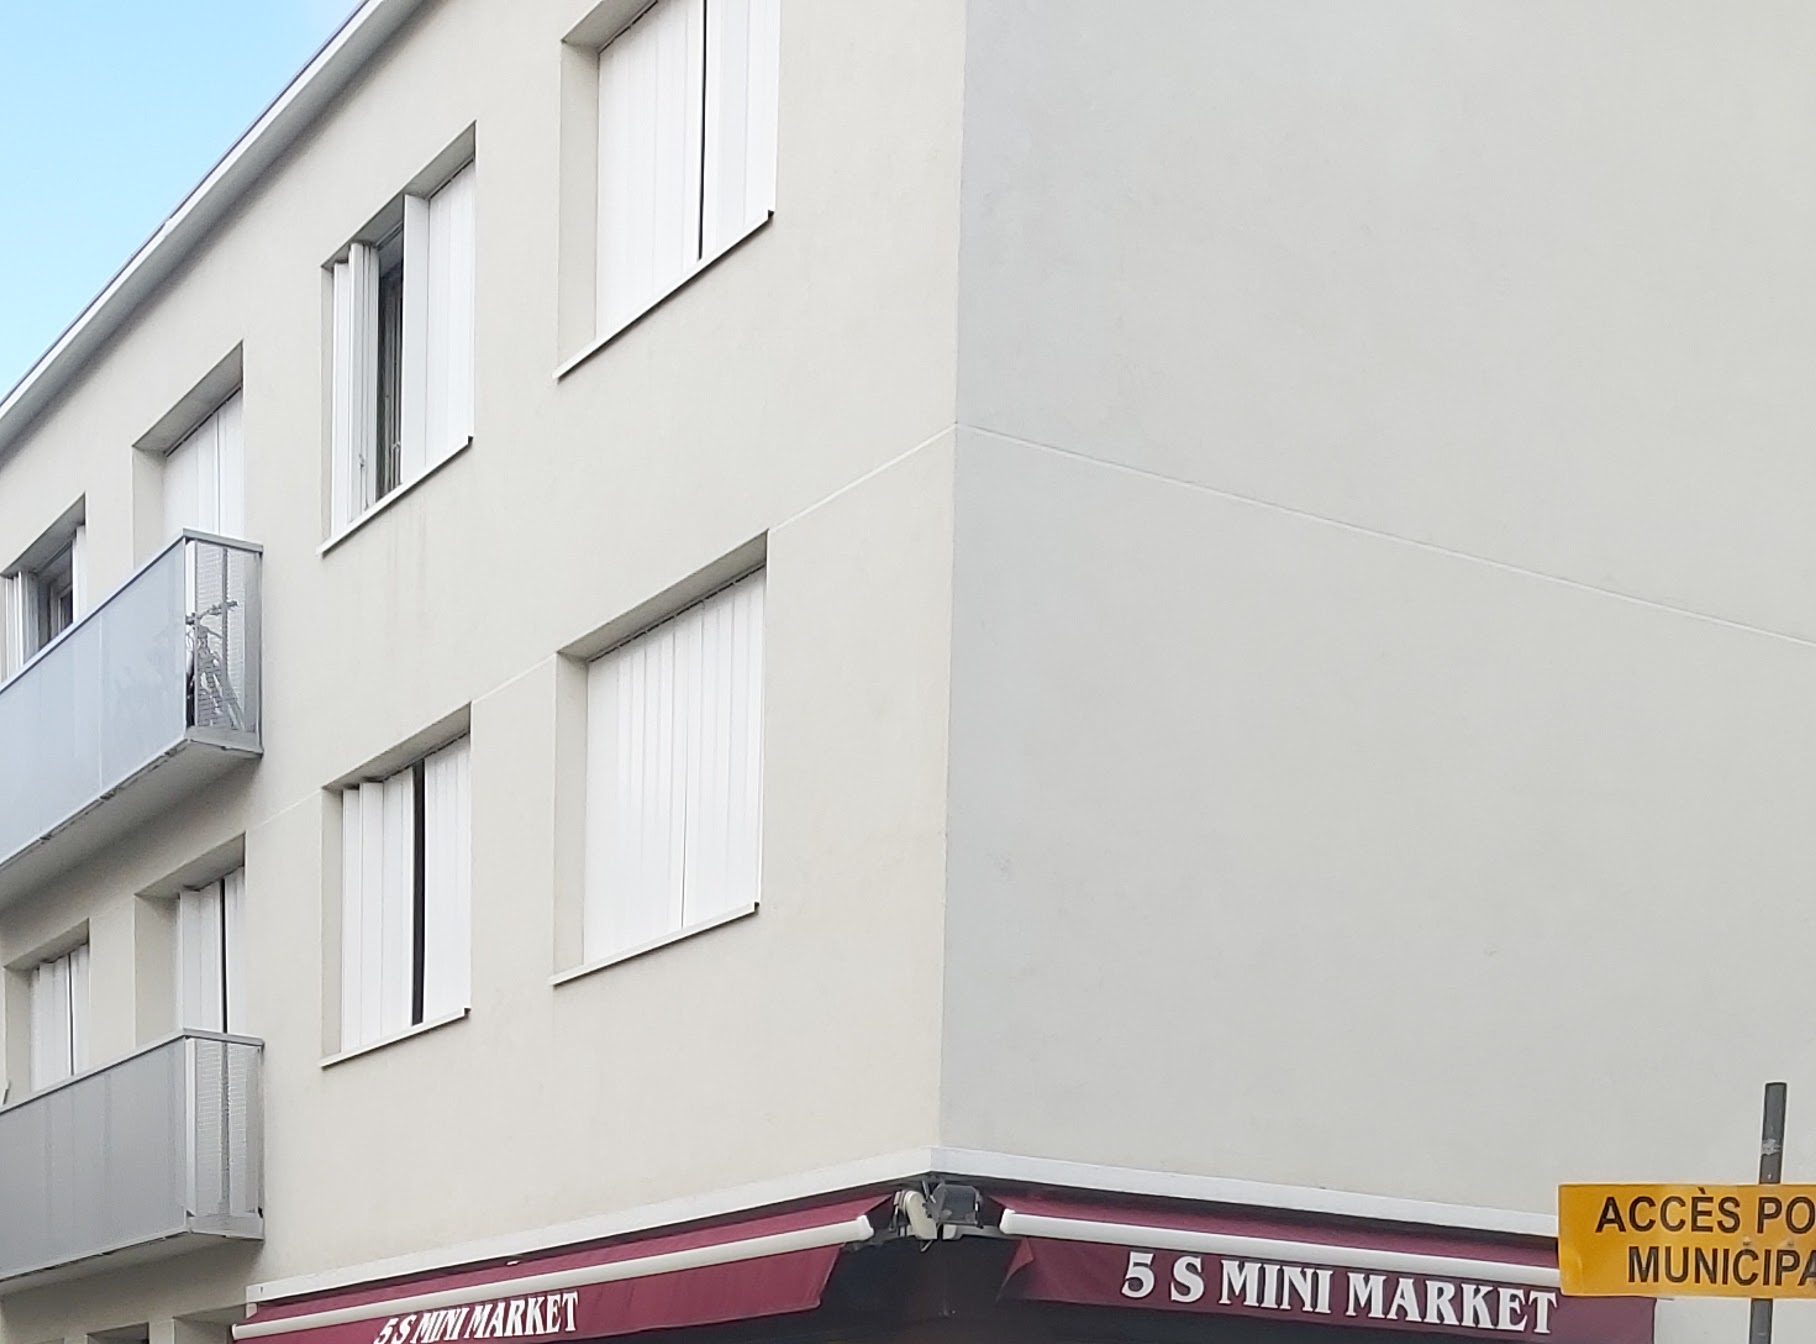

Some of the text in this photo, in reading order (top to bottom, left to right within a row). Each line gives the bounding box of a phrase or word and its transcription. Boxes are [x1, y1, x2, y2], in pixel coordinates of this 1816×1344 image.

[1595, 1187, 1740, 1233] ACCÈS
[410, 1307, 470, 1344] MINI
[463, 1291, 579, 1339] MARKET
[1121, 1251, 1558, 1334] 5 S MINI MARKET
